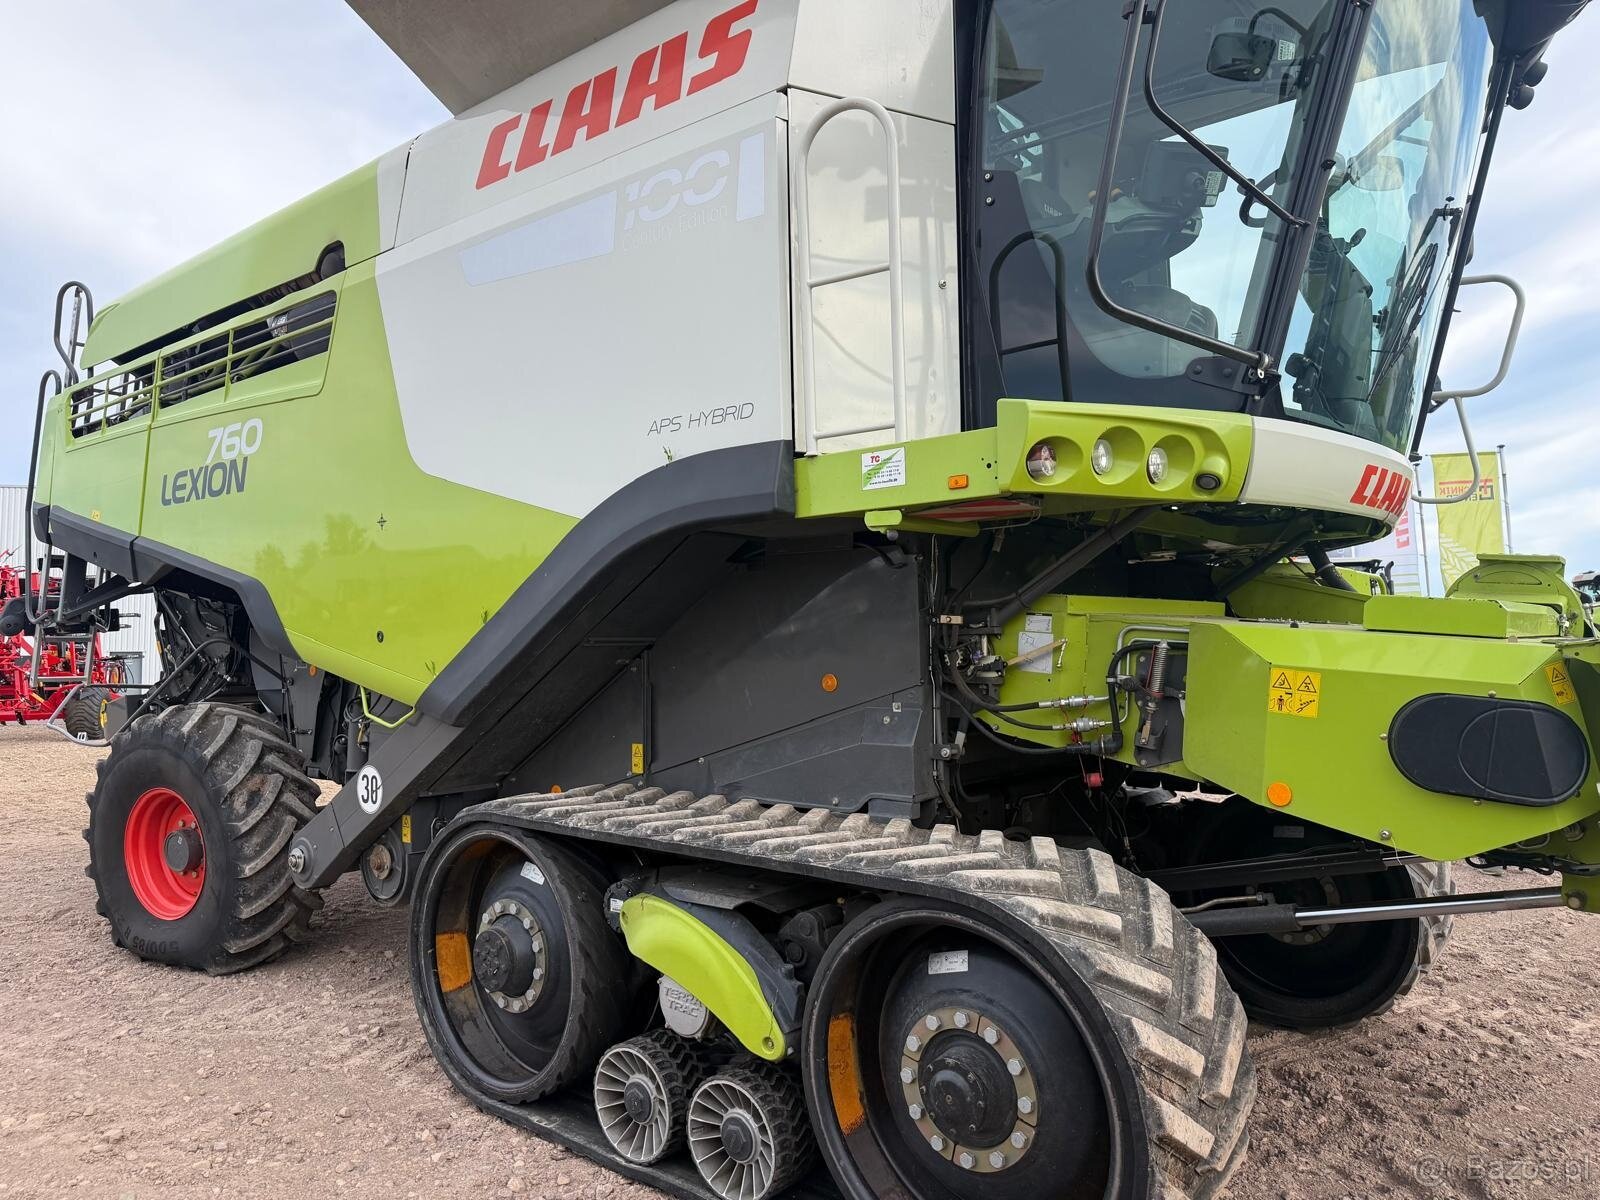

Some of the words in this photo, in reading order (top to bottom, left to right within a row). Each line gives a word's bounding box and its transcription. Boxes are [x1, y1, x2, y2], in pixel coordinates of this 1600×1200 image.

[476, 0, 759, 190] CLAAS
[206, 418, 263, 464] 760
[647, 415, 682, 436] APS
[688, 402, 755, 429] HYBRID
[161, 456, 248, 506] LEXION
[1349, 464, 1411, 517] CLAA
[361, 774, 378, 805] 30
[667, 998, 700, 1018] TRAC
